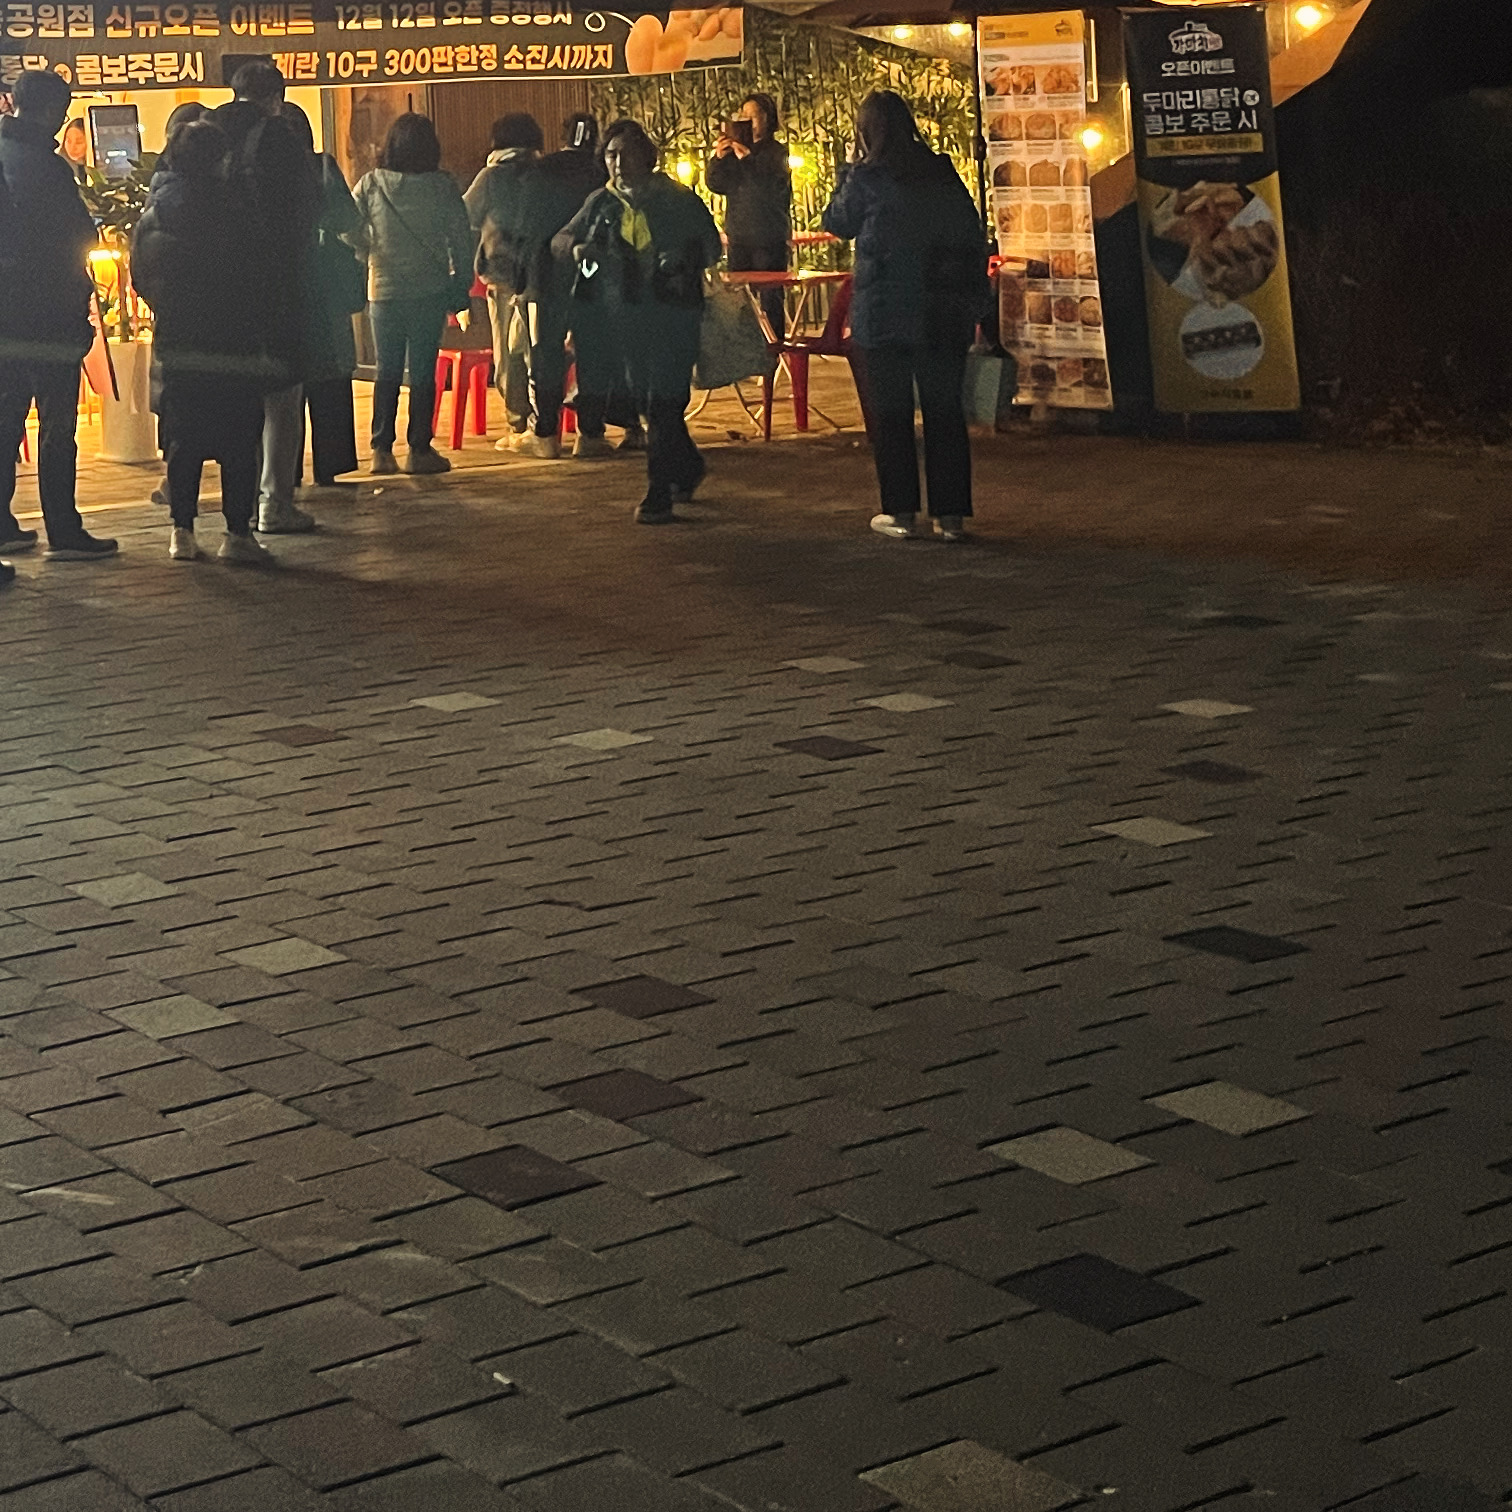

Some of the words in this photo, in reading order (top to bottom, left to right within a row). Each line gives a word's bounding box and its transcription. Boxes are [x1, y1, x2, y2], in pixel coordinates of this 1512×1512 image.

[104, 2, 220, 38] 신규오픈
[229, 2, 315, 37] 이벤트
[335, 1, 384, 30] 12월
[390, 0, 436, 28] 12일
[442, 0, 483, 25] 오픈
[75, 51, 205, 86] 콤보주문시
[326, 49, 379, 79] 10구
[384, 43, 499, 76] 300판한정
[503, 43, 614, 70] 소진시까지
[1160, 58, 1236, 77] 오픈이벤트
[1142, 87, 1240, 112] 두마리통닭
[1144, 113, 1186, 135] 콤보
[1190, 111, 1232, 133] 주문
[1237, 109, 1258, 130] 시
